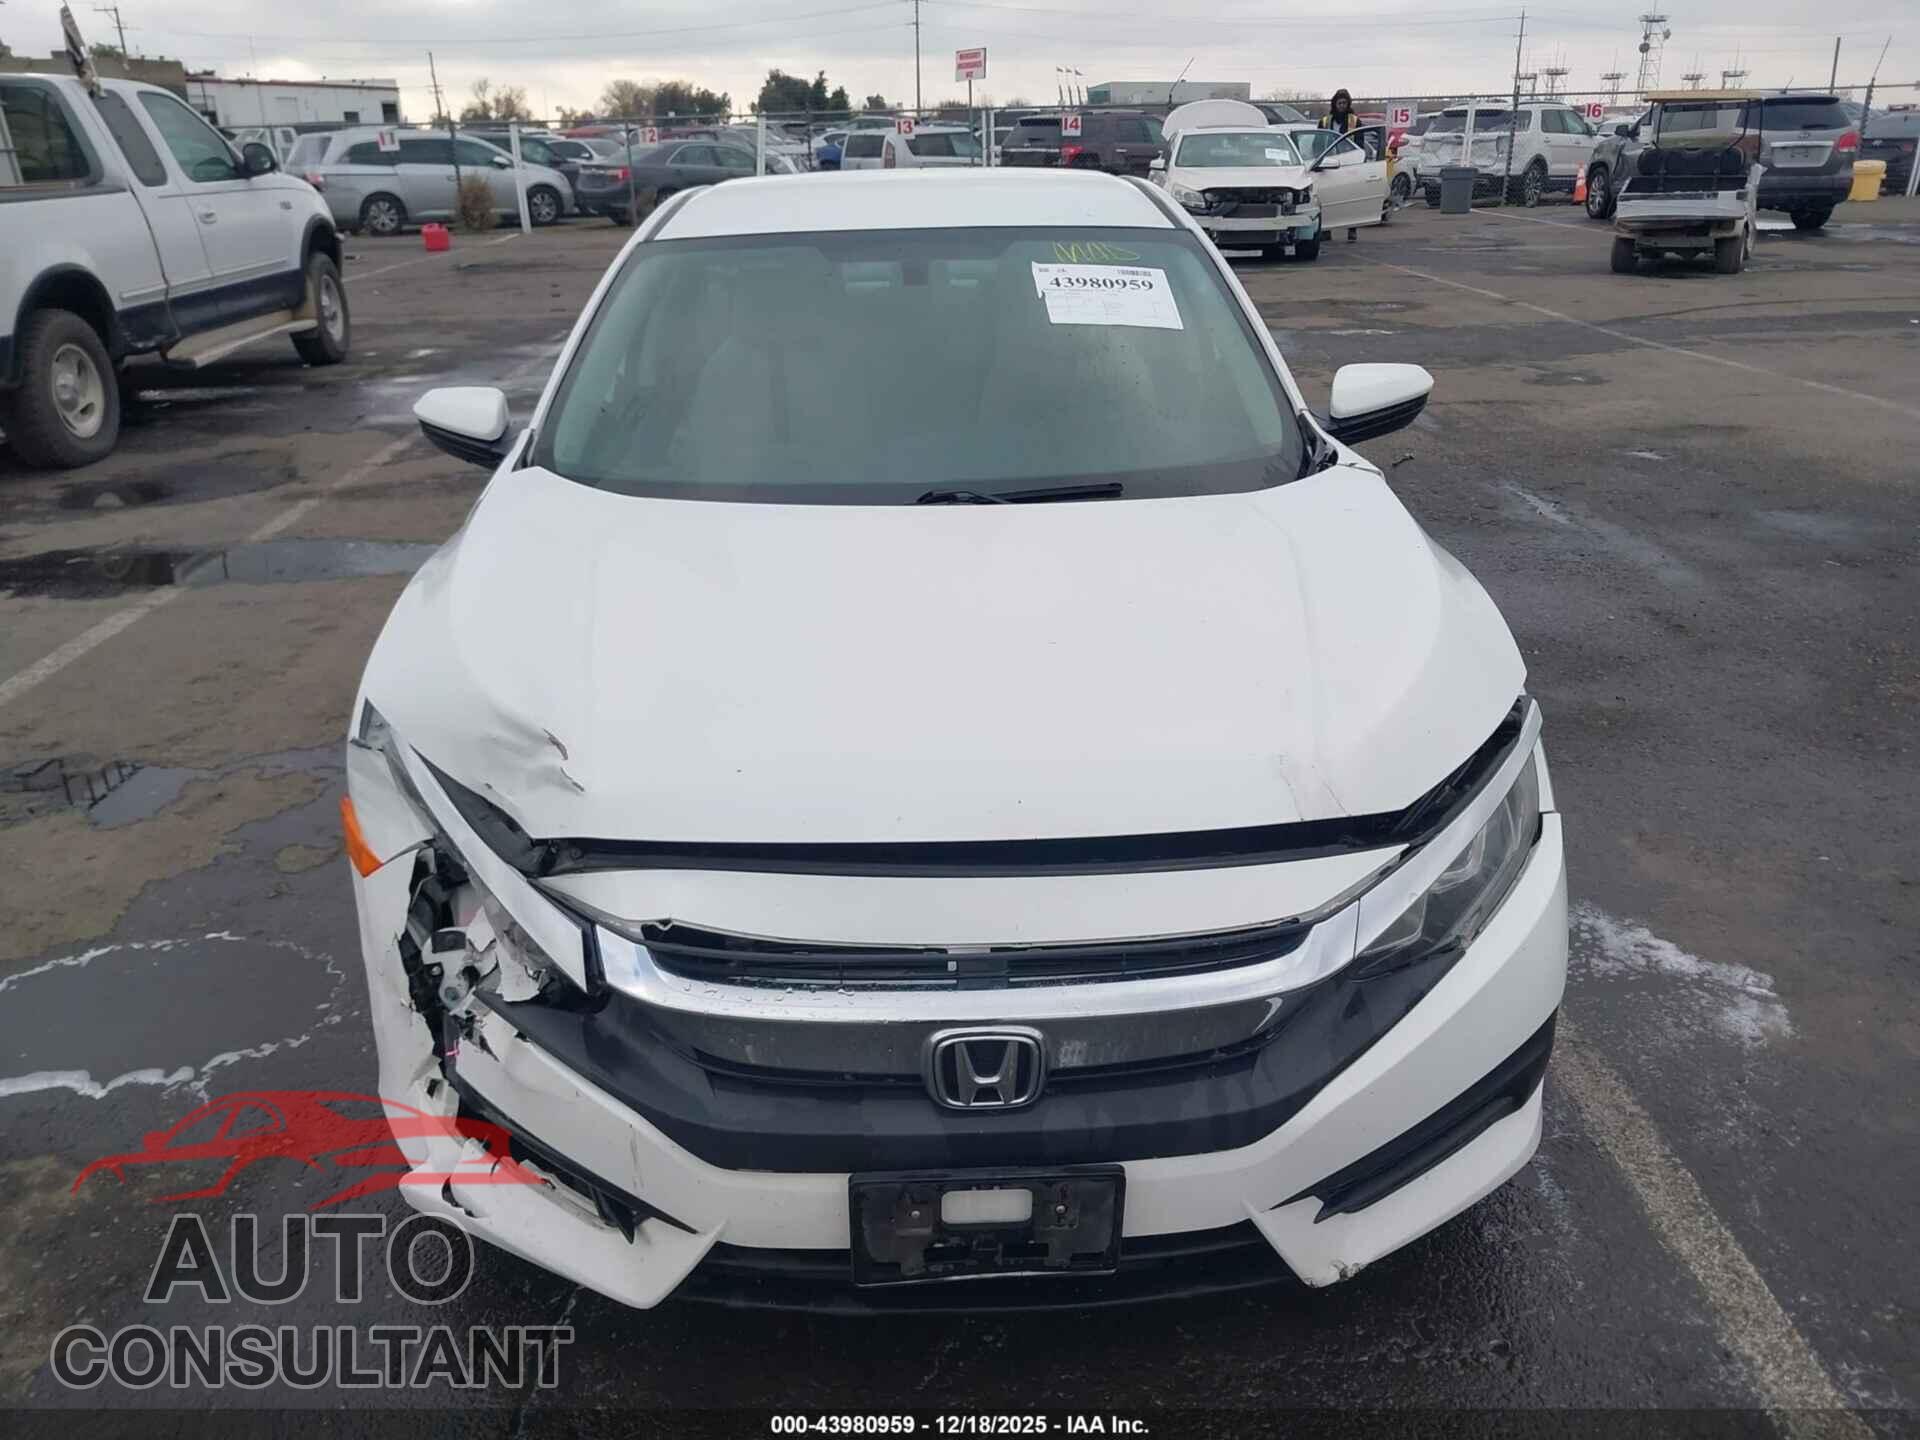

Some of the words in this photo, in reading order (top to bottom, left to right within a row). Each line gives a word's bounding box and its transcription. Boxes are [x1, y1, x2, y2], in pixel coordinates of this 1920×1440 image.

[1394, 109, 1409, 123] 15
[1586, 103, 1602, 118] 16
[896, 119, 912, 134] 13
[1063, 116, 1080, 131] 14
[1050, 276, 1154, 290] 43980959
